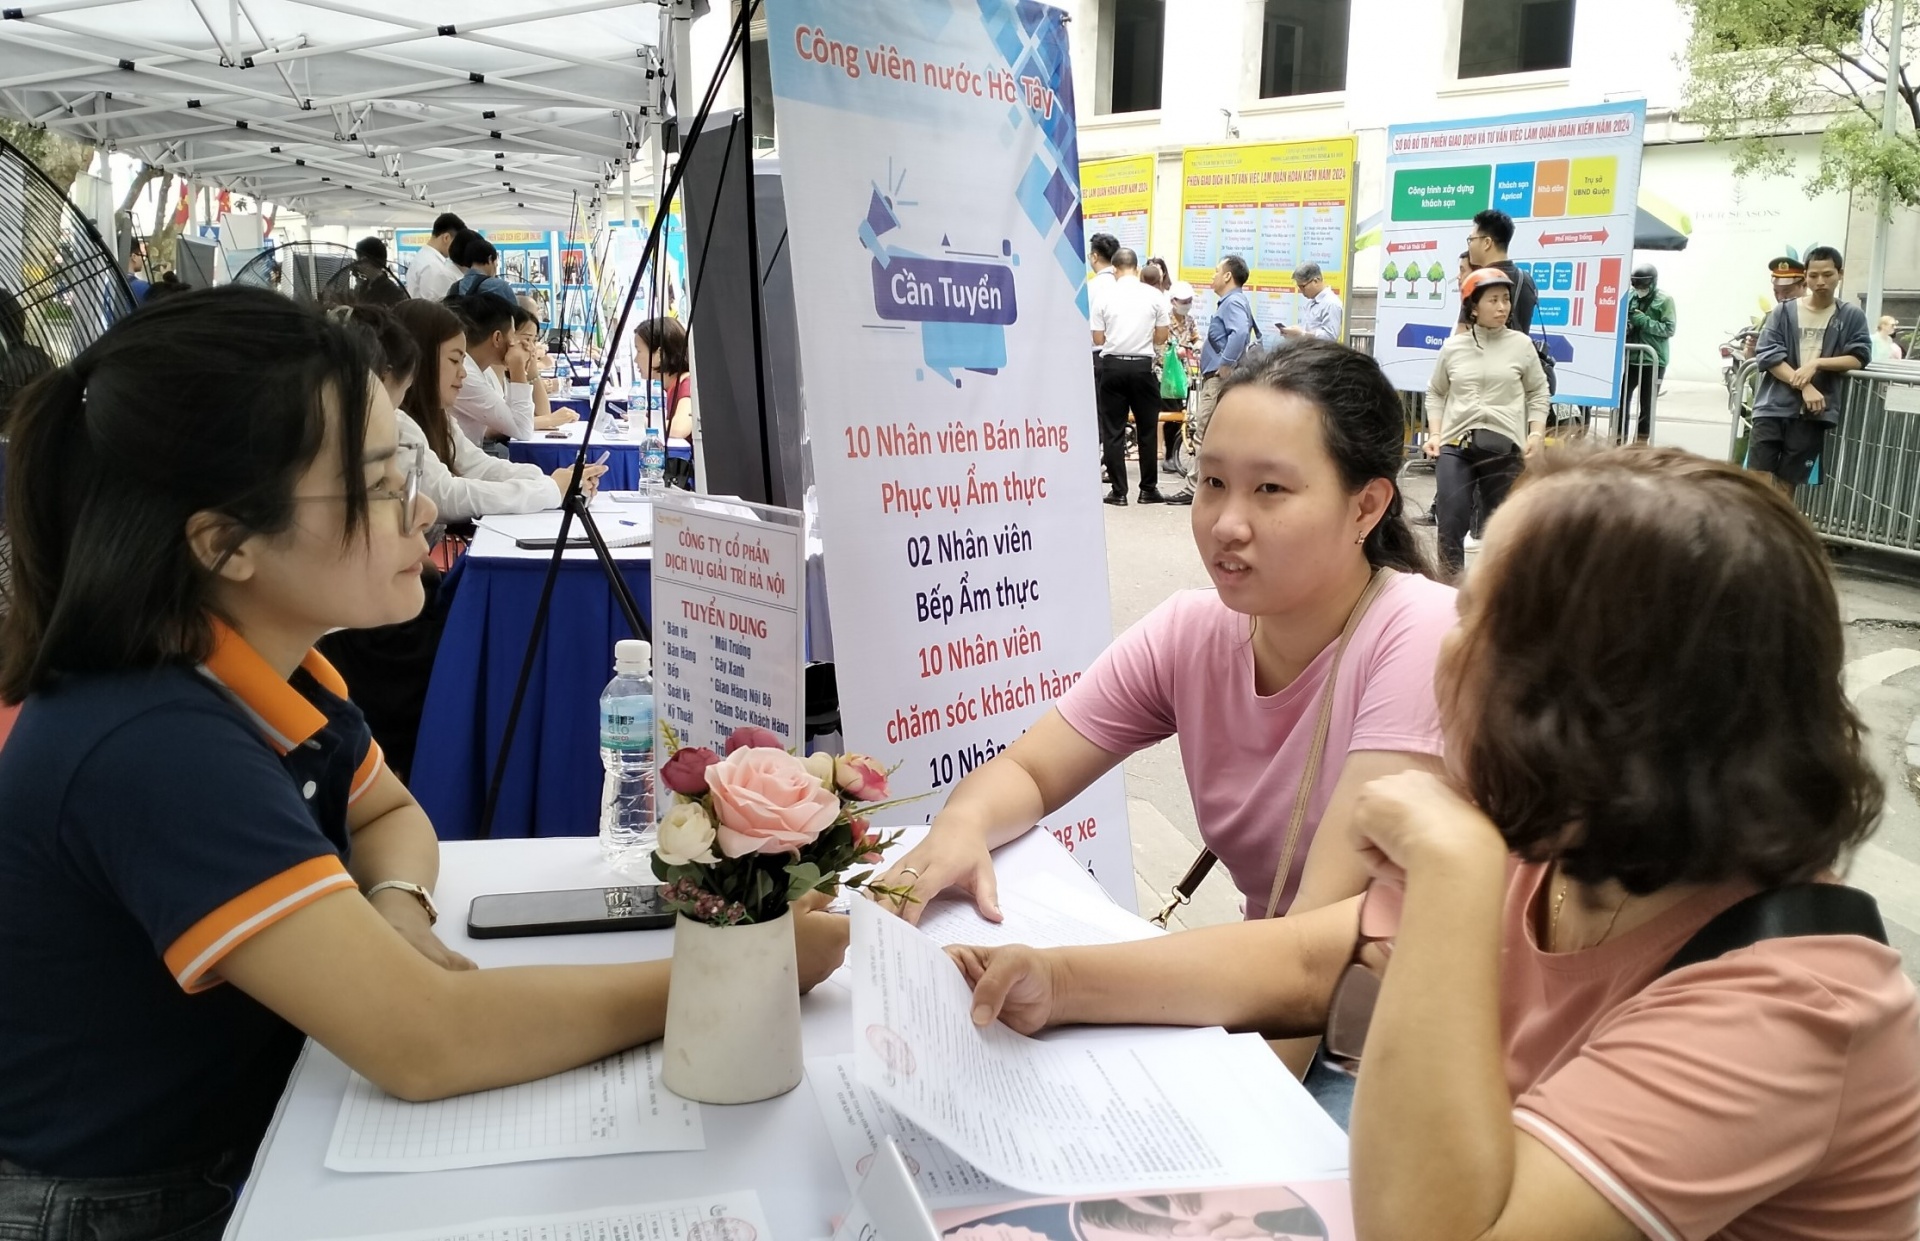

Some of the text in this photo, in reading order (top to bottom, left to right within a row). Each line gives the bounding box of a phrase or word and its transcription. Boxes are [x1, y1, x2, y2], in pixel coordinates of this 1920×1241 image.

[795, 25, 1054, 119] Công viên nước Hồ Tây
[1613, 119, 1630, 132] 2024
[1332, 168, 1346, 180] 2024
[1408, 186, 1426, 196] Công
[1427, 185, 1441, 194] trình
[1457, 184, 1475, 194] dựng
[1422, 199, 1456, 208] khách sạn
[1574, 187, 1610, 196] UBND Quận
[890, 269, 1002, 316] Cần Tuyển
[1425, 336, 1442, 345] Gian
[844, 419, 1069, 459] 10 Nhân viên Bán hàng
[881, 464, 1047, 518] Phục vụ Ẩm thực
[679, 526, 705, 551] CÔNG
[708, 537, 722, 554] TY
[725, 531, 740, 558] CỔ
[906, 523, 1033, 568] 02 Nhân viên
[665, 552, 785, 600] DỊCH VỤ GIẢI TRÍ HÀ NỘI
[915, 571, 1040, 625] Bếp Ẩm thực
[681, 596, 767, 640] TUYỂN DỤNG
[918, 625, 1042, 679] 10 Nhân viên
[667, 662, 680, 679] Bếp
[729, 660, 745, 678] Xanh
[715, 678, 729, 695] Giao
[749, 709, 770, 729] Khách
[886, 704, 940, 745] chăm
[946, 695, 978, 730] sóc
[982, 680, 1036, 718] khách
[929, 753, 954, 788] 10
[1077, 817, 1097, 842] xe
